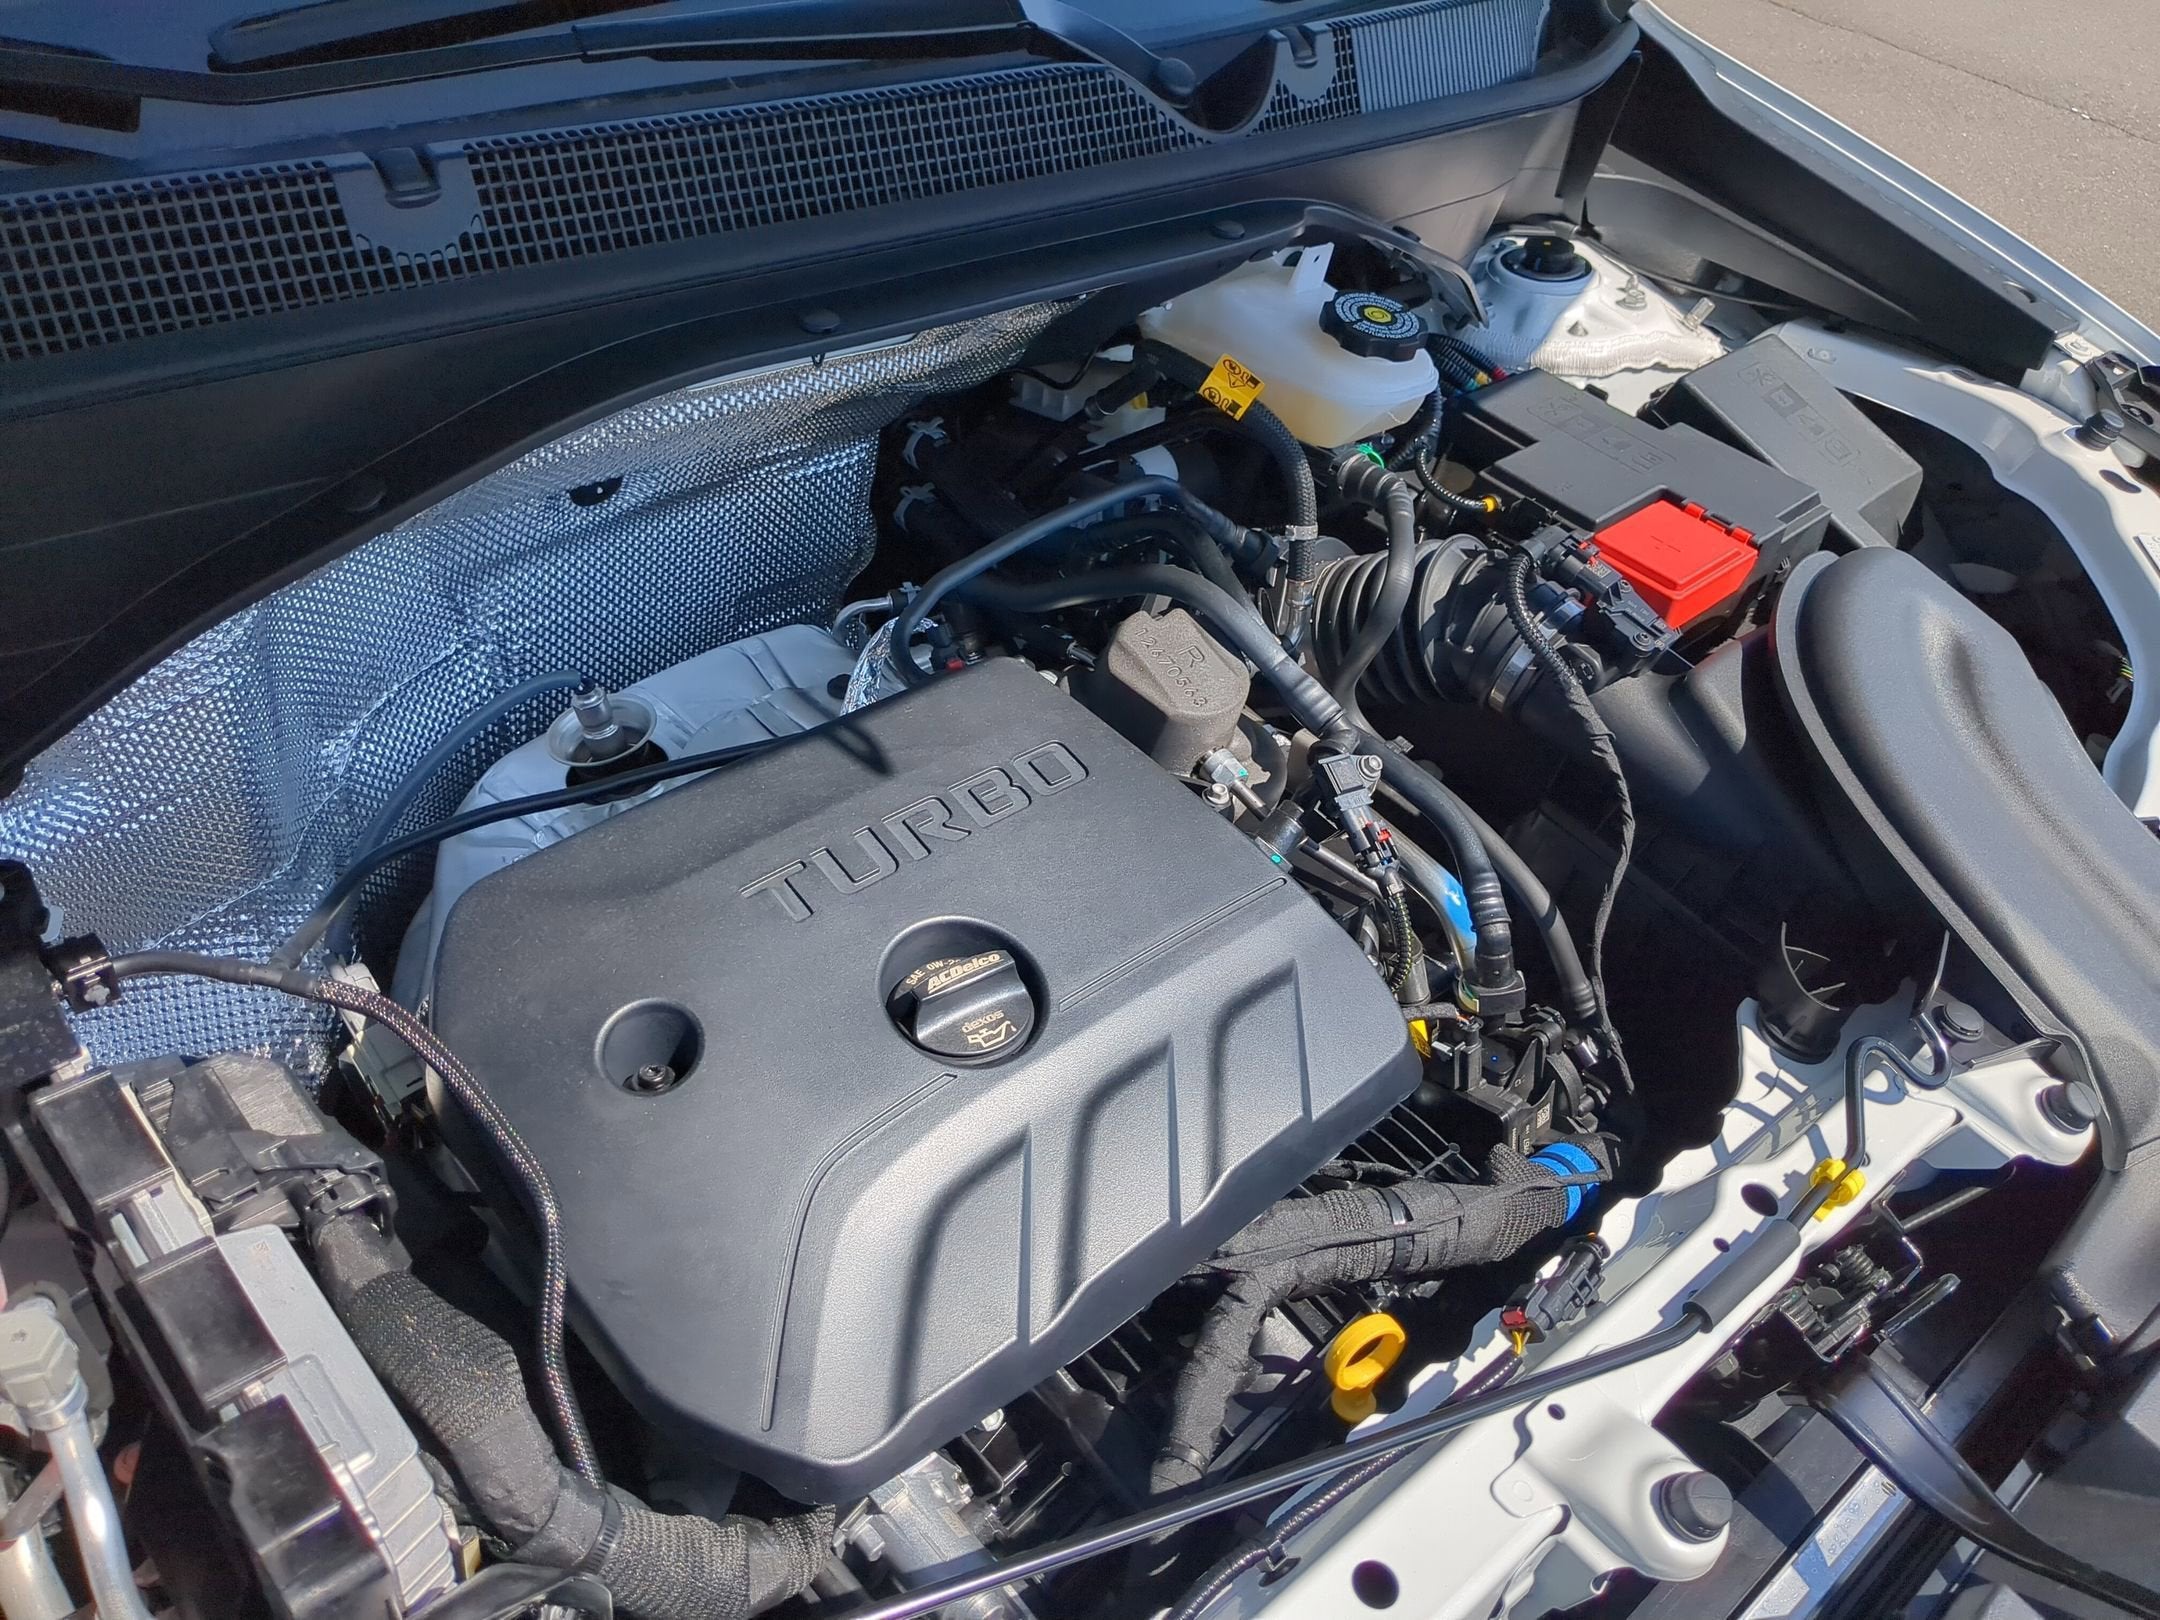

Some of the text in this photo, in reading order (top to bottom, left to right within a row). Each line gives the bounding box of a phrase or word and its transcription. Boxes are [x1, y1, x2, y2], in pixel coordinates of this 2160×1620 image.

[737, 739, 1090, 923] TURBO
[905, 969, 926, 986] SAE
[927, 953, 1001, 992] ACDelco
[961, 1009, 1005, 1034] dexos
